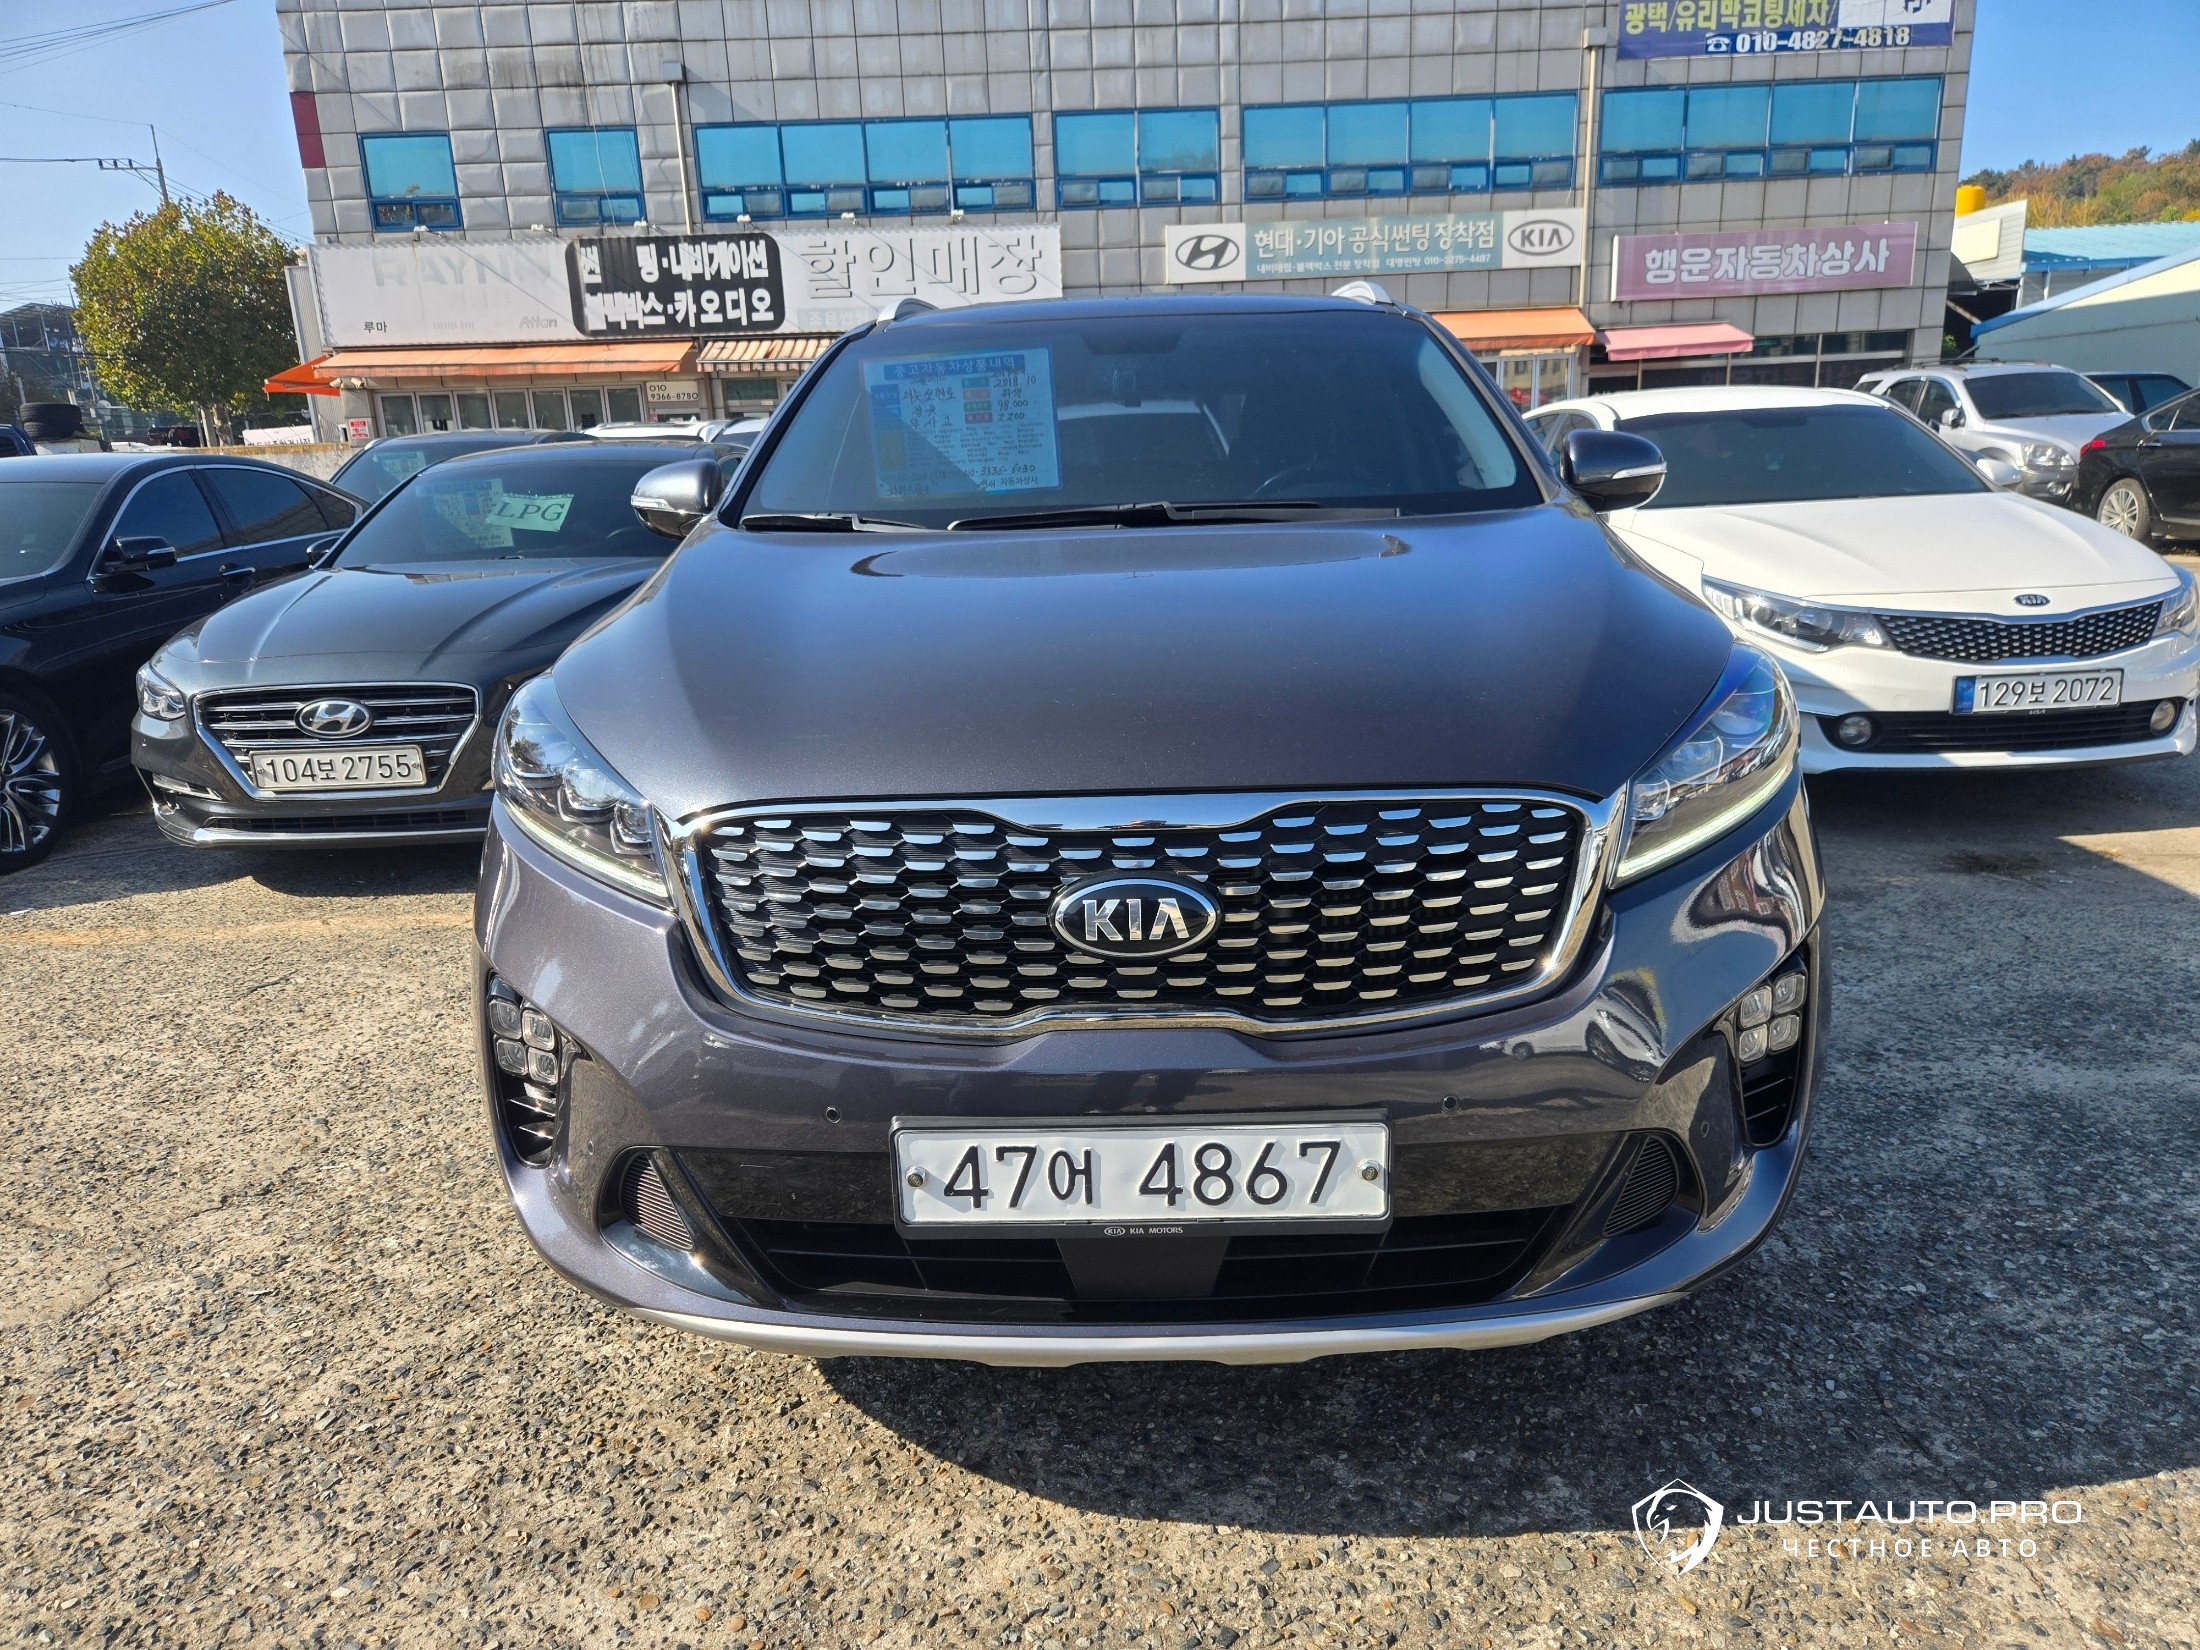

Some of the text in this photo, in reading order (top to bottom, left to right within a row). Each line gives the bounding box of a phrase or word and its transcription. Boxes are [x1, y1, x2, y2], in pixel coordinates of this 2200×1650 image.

[1736, 26, 1910, 53] 010-4827-4818
[1434, 218, 1496, 250] 장착점
[1521, 228, 1563, 248] KIA
[800, 234, 1043, 299] 할인매장
[1644, 238, 1890, 285] 행운자동차상사
[363, 321, 388, 334] 루마
[894, 356, 1015, 380] 중고자동차상품내역
[649, 384, 667, 392] 010
[494, 501, 566, 522] LPG
[1978, 676, 2115, 707] 129보 2072
[265, 754, 411, 783] 104보 2755
[1082, 897, 1190, 942] KIA
[942, 1139, 1342, 1209] 47어 4867
[1130, 1227, 1145, 1235] KIA
[1148, 1226, 1184, 1235] MOTORS
